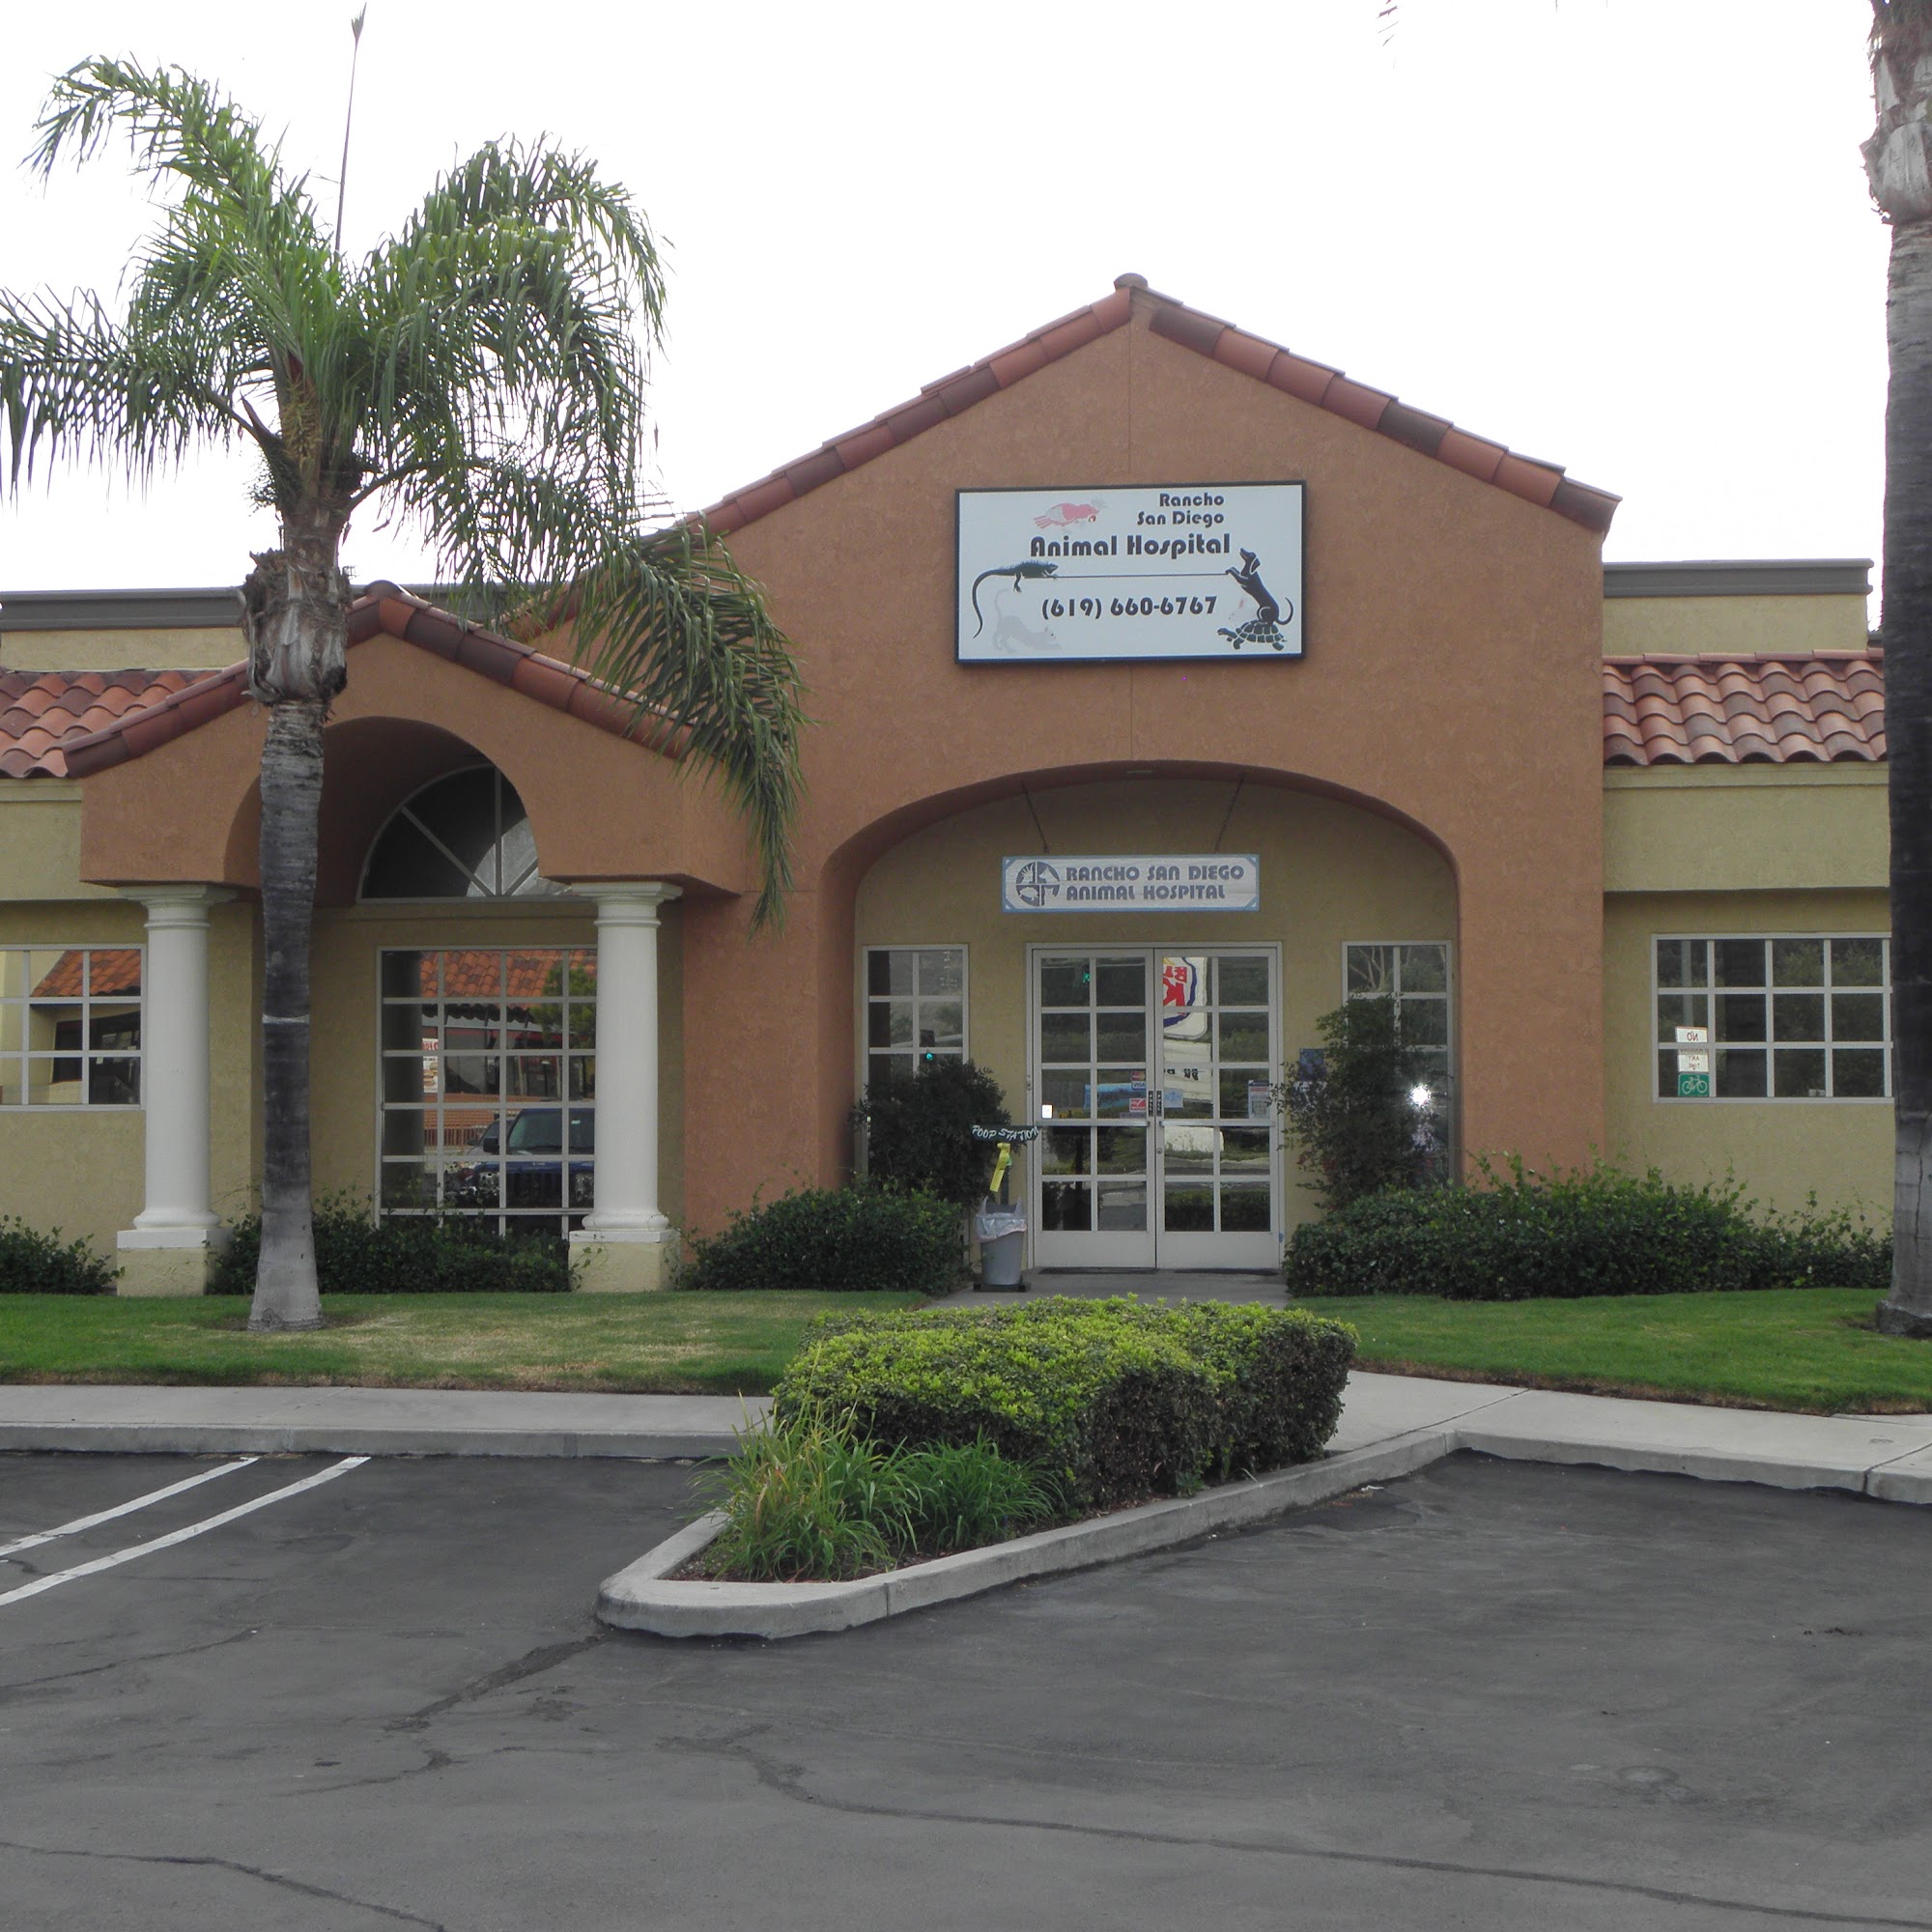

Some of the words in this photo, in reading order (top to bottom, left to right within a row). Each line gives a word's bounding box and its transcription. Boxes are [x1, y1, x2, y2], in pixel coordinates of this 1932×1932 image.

[1159, 493, 1225, 507] Rancho
[1137, 511, 1167, 526] San
[1172, 510, 1225, 528] Diego
[1030, 535, 1118, 557] Animal
[1126, 533, 1231, 559] Hospital
[1041, 598, 1102, 619] (619)
[1110, 596, 1218, 616] 660-6767
[1065, 866, 1140, 881] RANCHO
[1148, 865, 1180, 880] SAN
[1188, 865, 1244, 880] DIEGO
[1066, 885, 1135, 900] ANIMAL
[1144, 884, 1225, 899] HOSPITAL
[971, 1124, 997, 1139] POOP
[998, 1125, 1039, 1141] STATION
